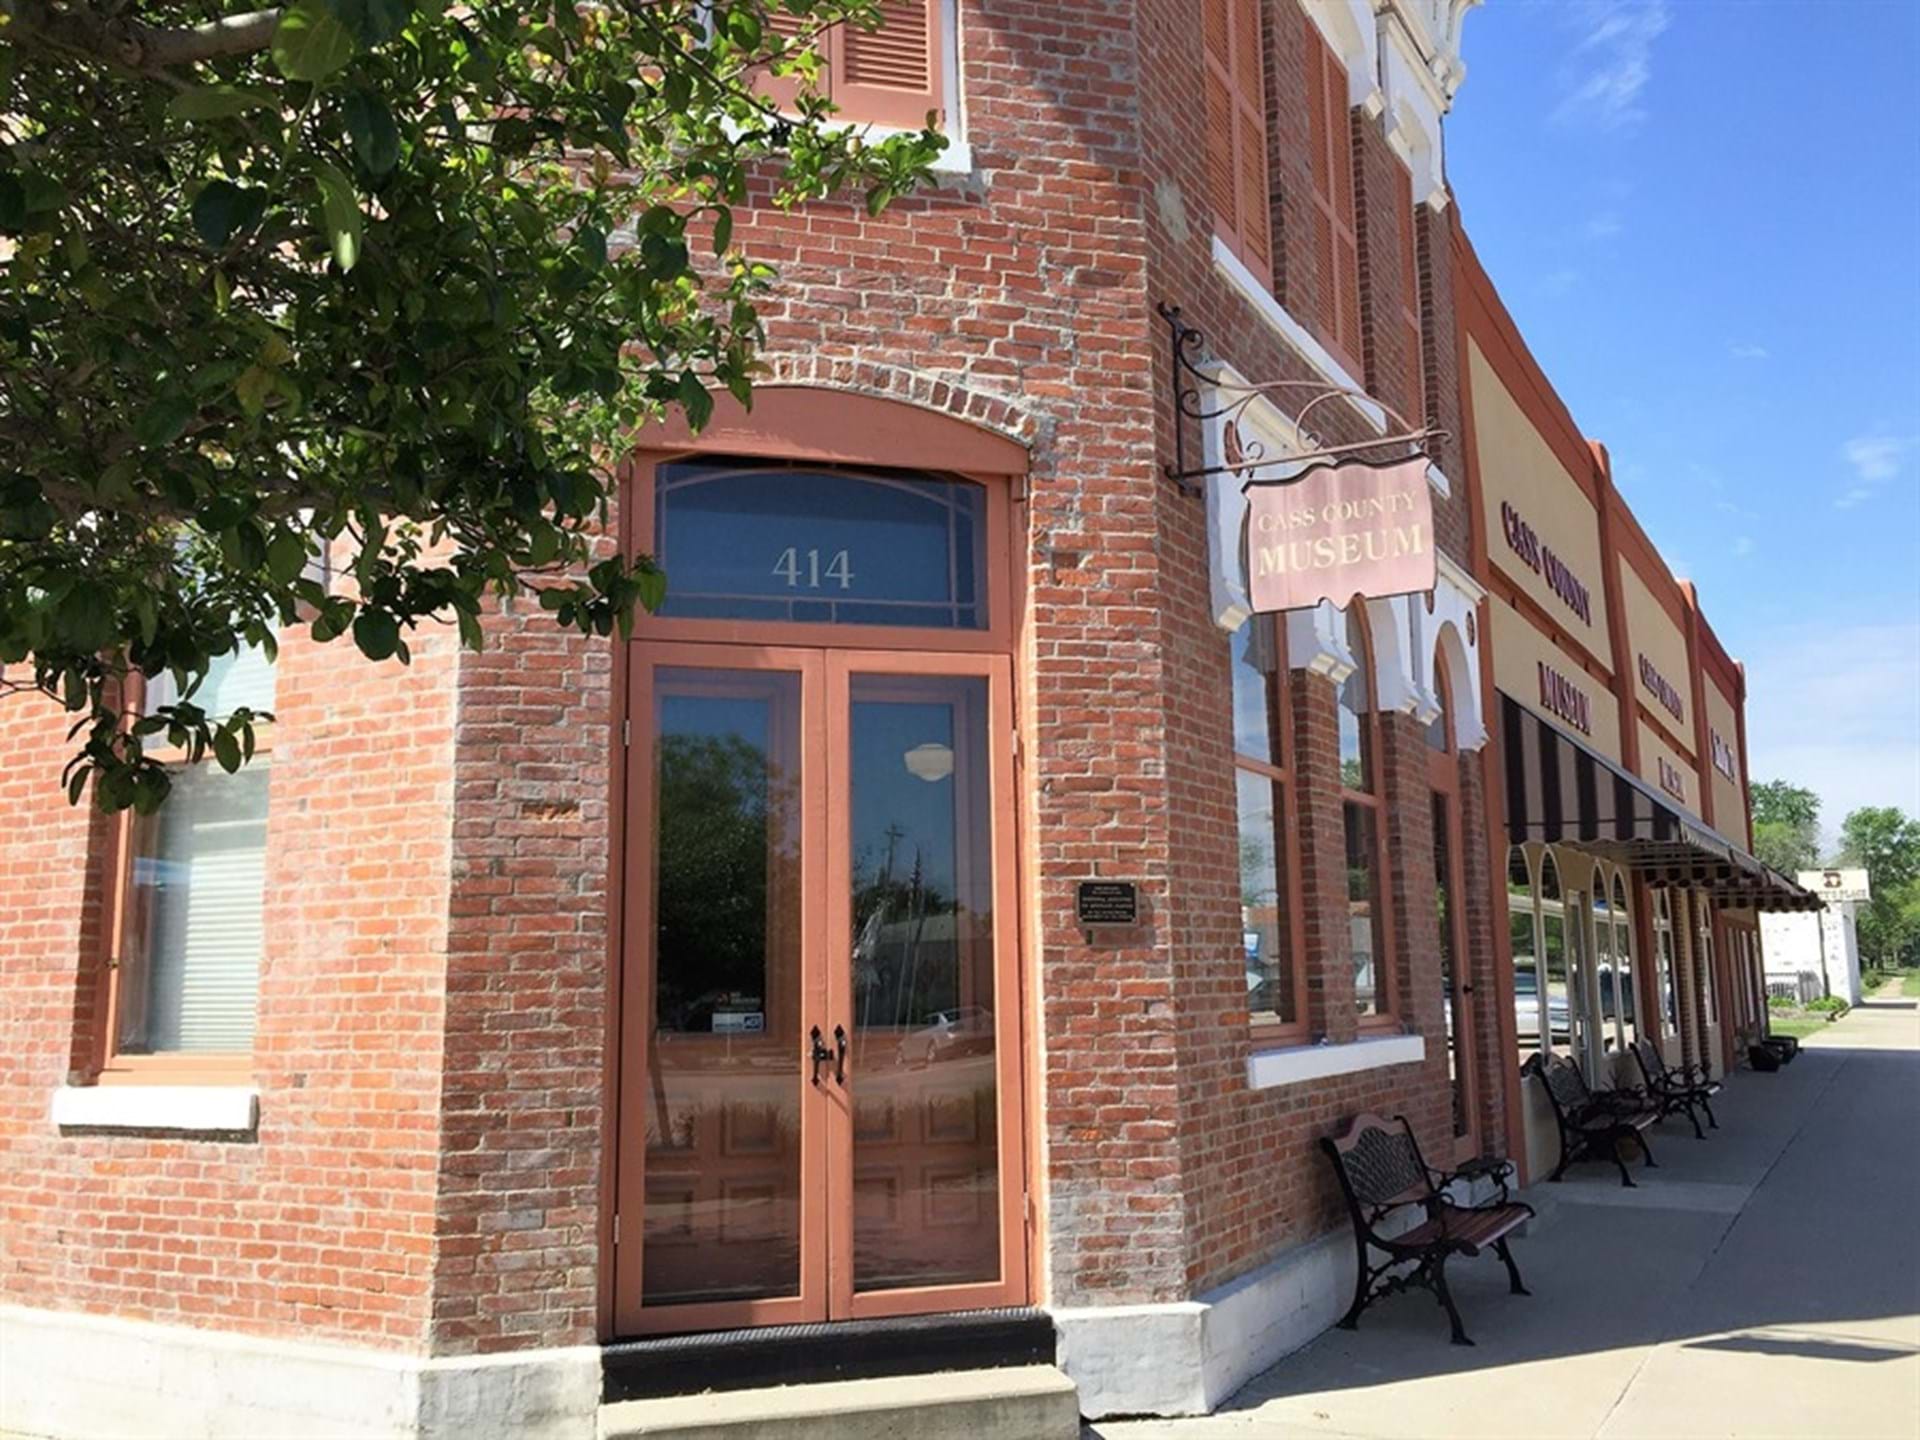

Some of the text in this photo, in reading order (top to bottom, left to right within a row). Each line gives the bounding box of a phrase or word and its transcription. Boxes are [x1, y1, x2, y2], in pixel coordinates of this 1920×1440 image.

[1257, 490, 1418, 533] CASS COUNTY
[771, 546, 856, 590] 414
[1257, 523, 1424, 577] MUSEUM
